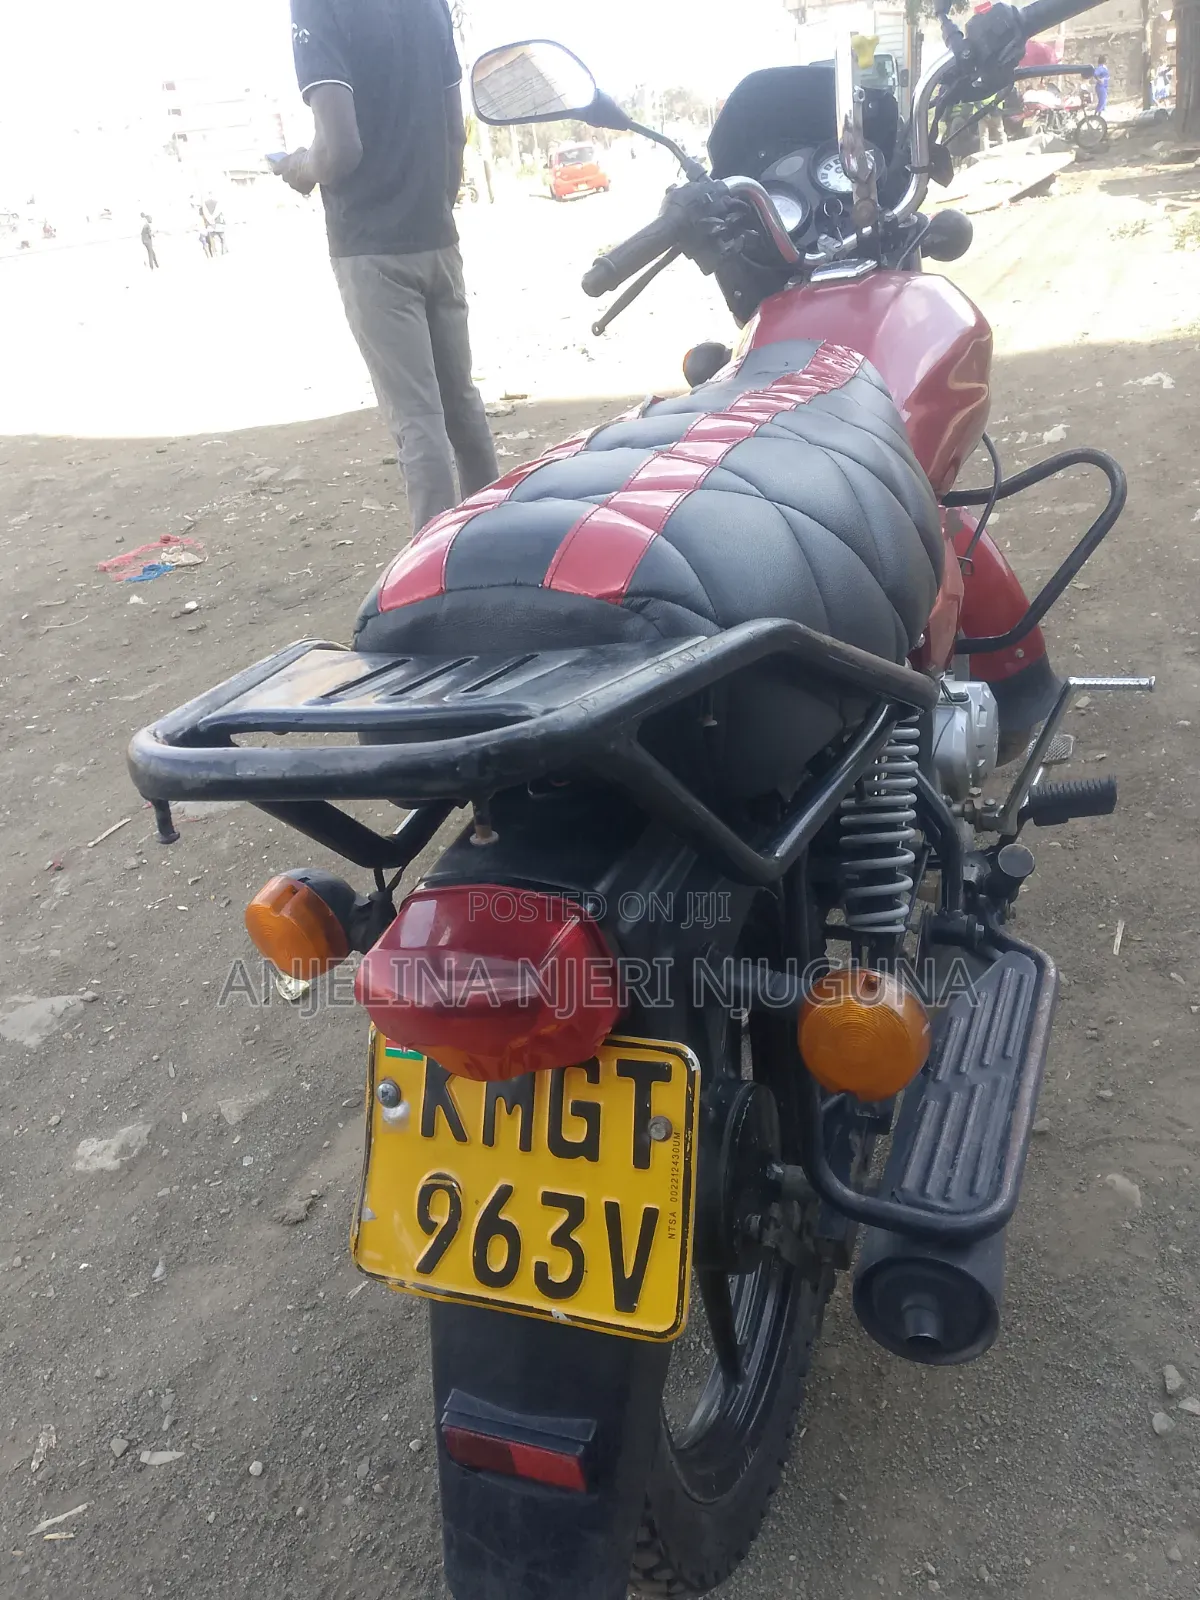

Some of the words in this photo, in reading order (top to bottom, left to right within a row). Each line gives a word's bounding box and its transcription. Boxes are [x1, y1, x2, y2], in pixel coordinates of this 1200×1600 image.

[421, 1054, 672, 1169] KMGT
[416, 1172, 660, 1313] 963V
[667, 1211, 677, 1240] NTSA
